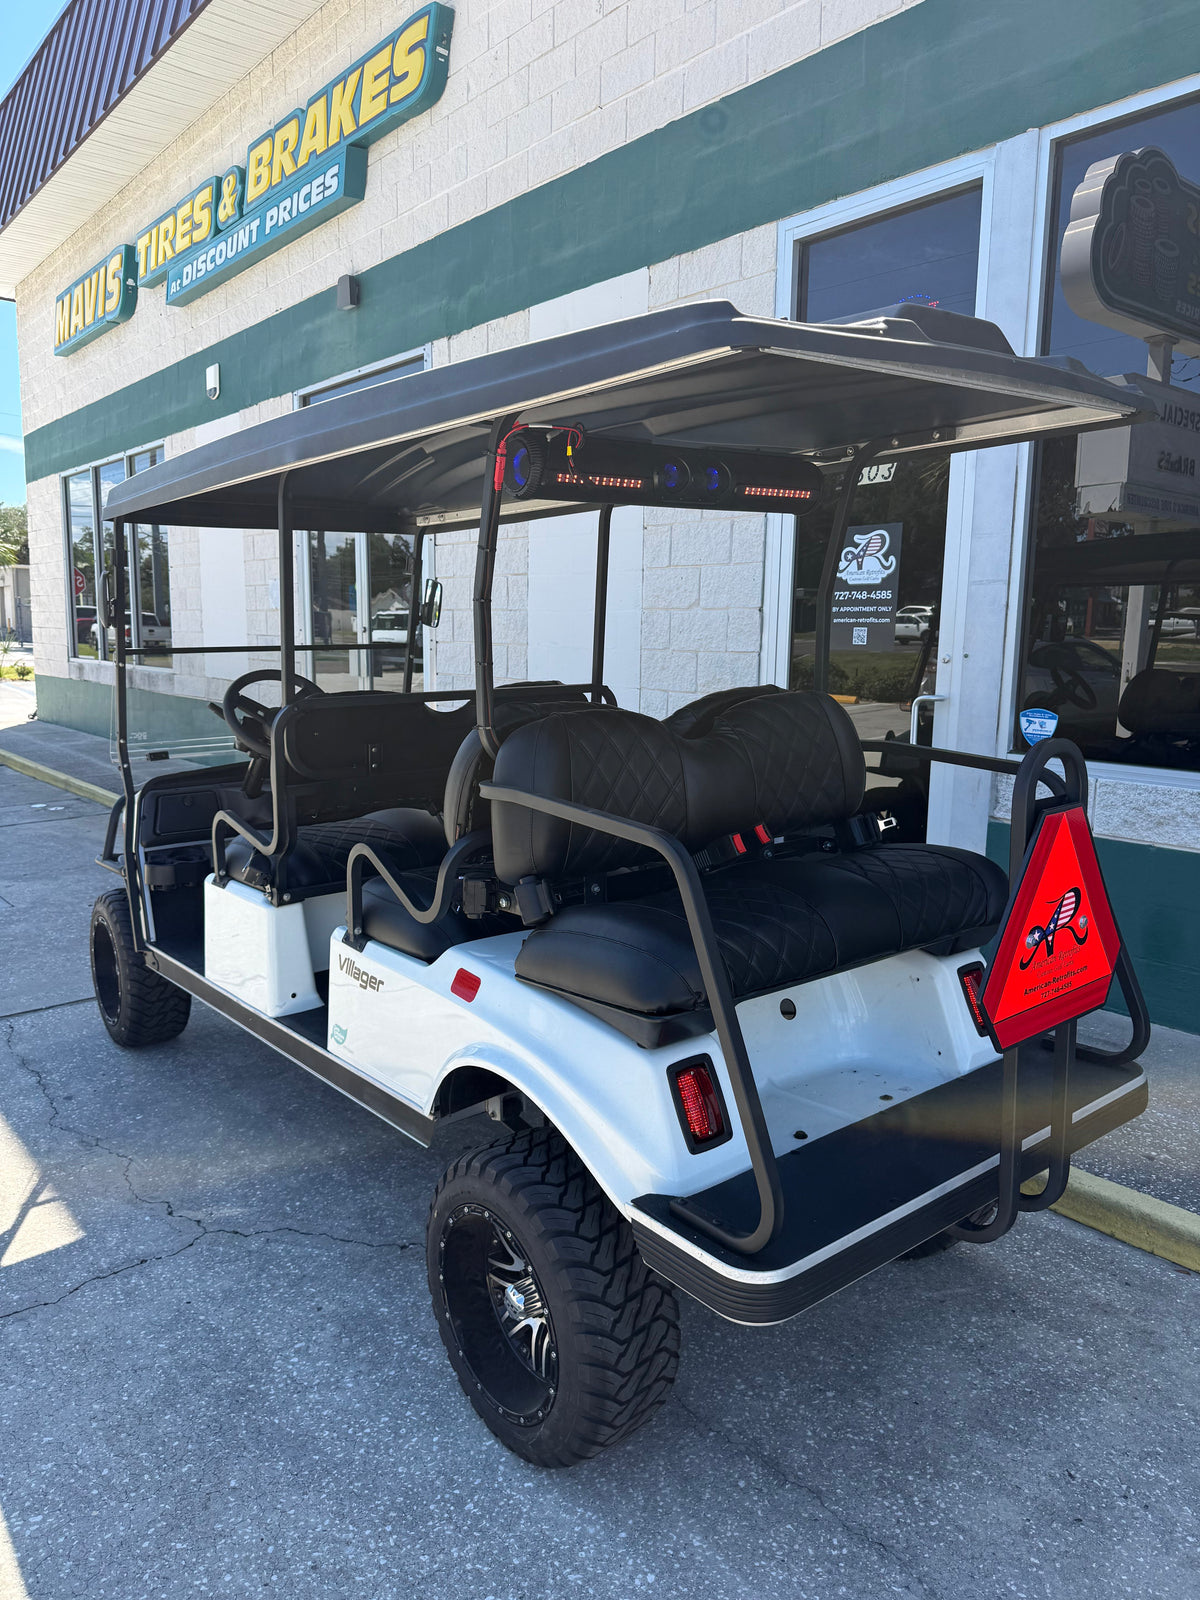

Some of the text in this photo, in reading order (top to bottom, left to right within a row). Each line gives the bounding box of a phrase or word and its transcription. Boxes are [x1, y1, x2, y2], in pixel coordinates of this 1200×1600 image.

[55, 15, 429, 347] MAVIS TIRES & BRAKES
[170, 164, 340, 296] At DISCOUNT PRICES
[834, 590, 892, 600] 727-748-4585
[339, 954, 384, 992] Villager
[1023, 965, 1088, 996] American-Retrofits.com
